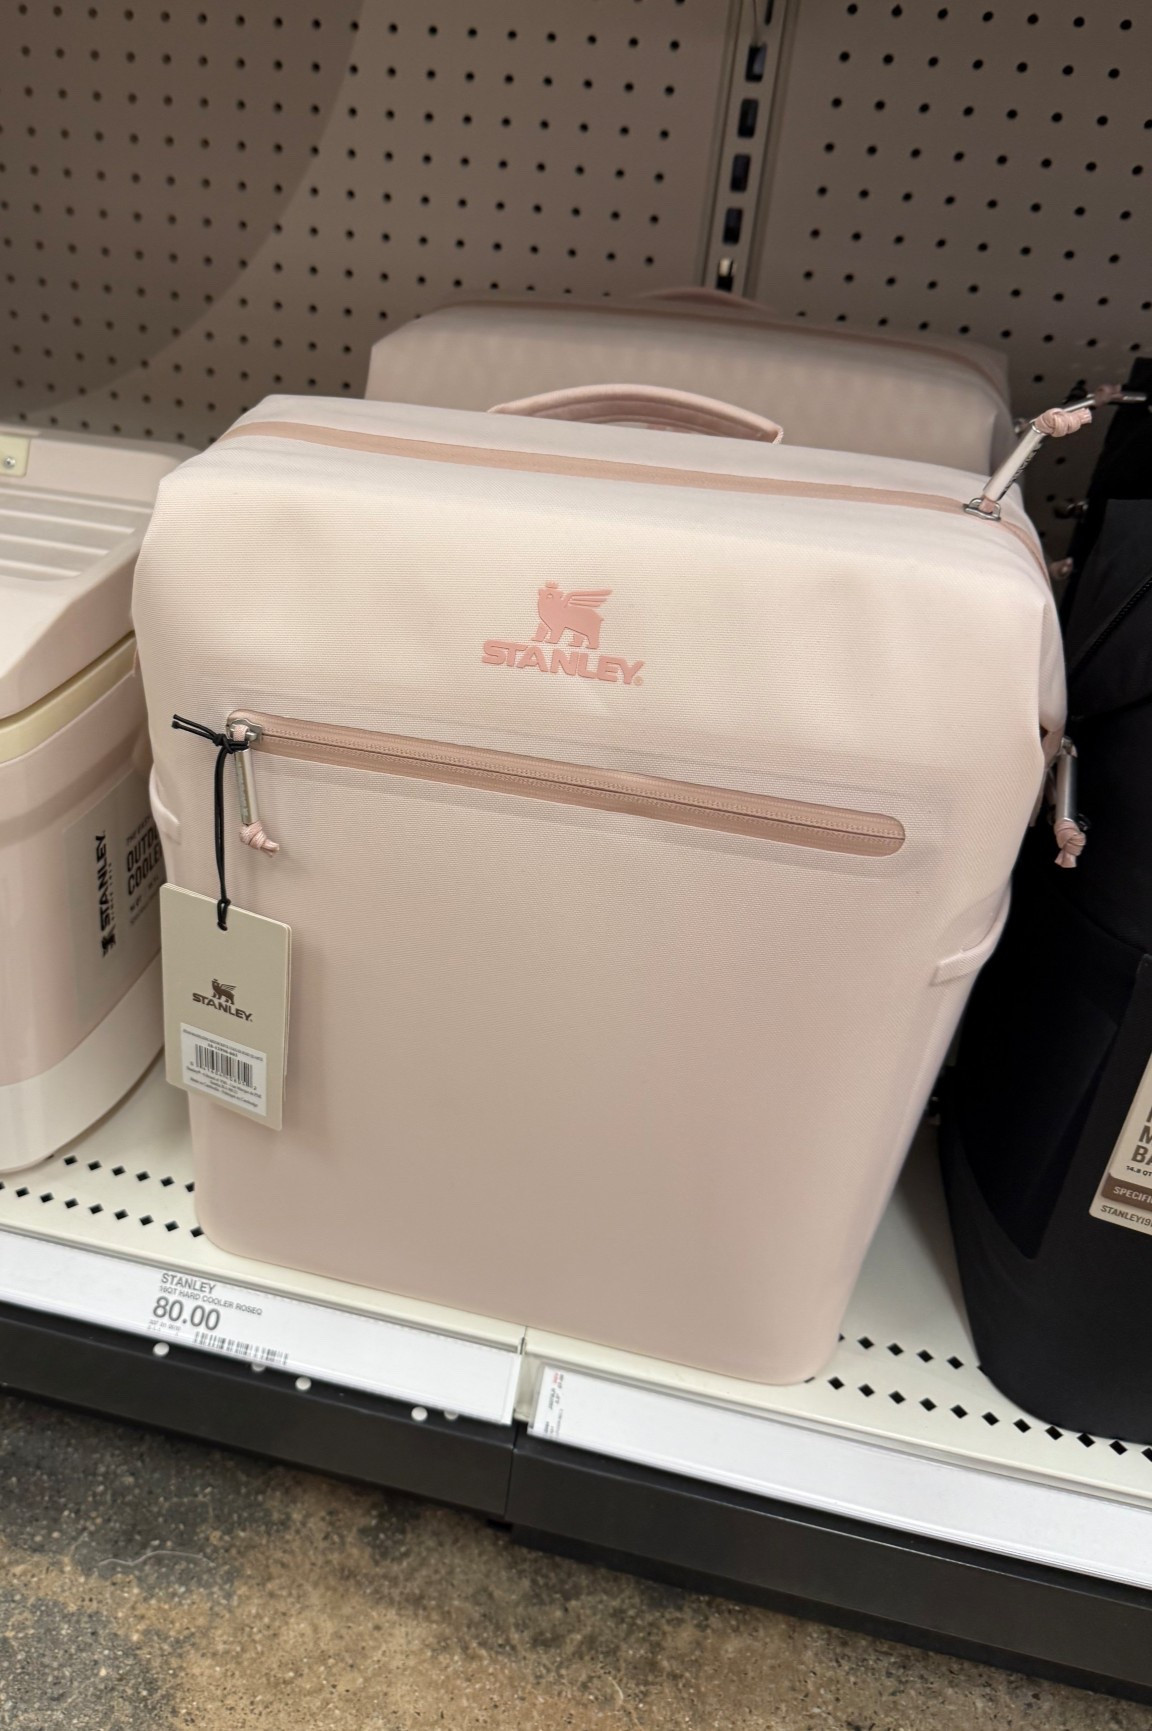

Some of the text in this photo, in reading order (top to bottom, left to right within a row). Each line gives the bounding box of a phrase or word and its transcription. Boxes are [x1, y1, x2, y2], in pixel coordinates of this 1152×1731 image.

[192, 992, 253, 1023] STANLEY
[1101, 1204, 1152, 1227] STANLEY19
[161, 1272, 216, 1295] STANLEY
[179, 1289, 201, 1301] HARD
[202, 1295, 234, 1310] COOLER
[153, 1296, 221, 1331] 80.00
